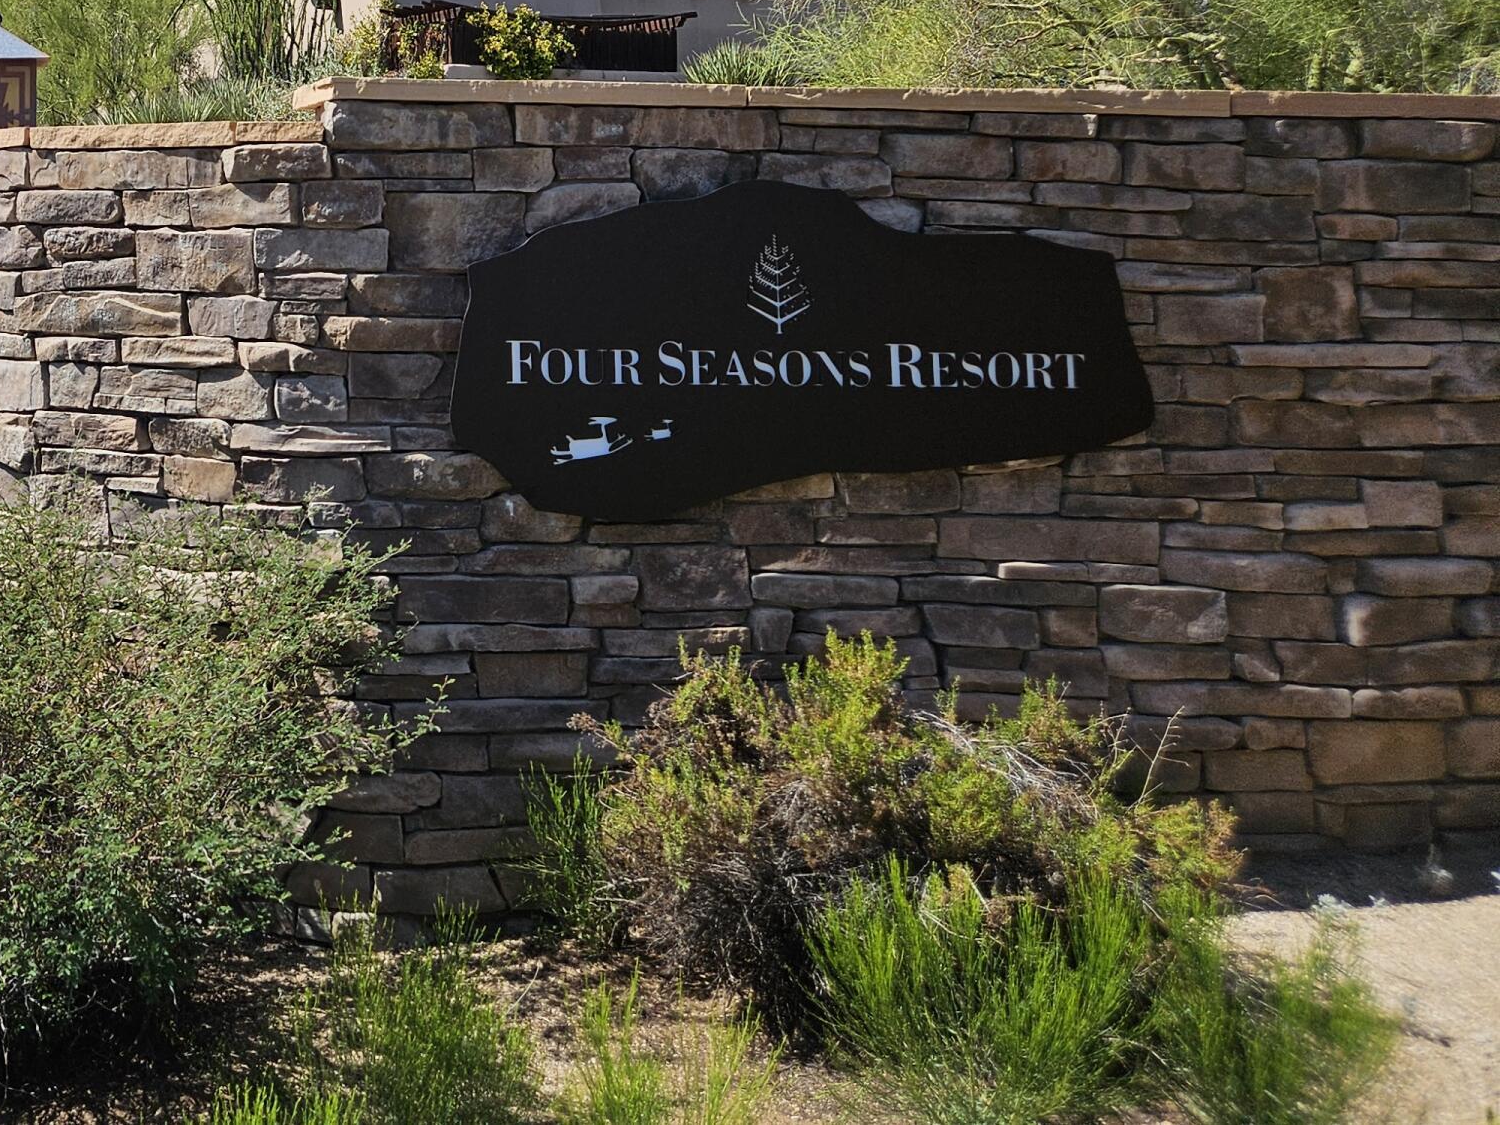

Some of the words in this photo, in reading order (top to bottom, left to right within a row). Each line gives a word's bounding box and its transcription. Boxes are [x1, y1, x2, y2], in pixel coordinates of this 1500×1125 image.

[504, 339, 643, 386] FOUR
[657, 340, 872, 388] SEASONS
[885, 343, 1086, 390] RESORT
